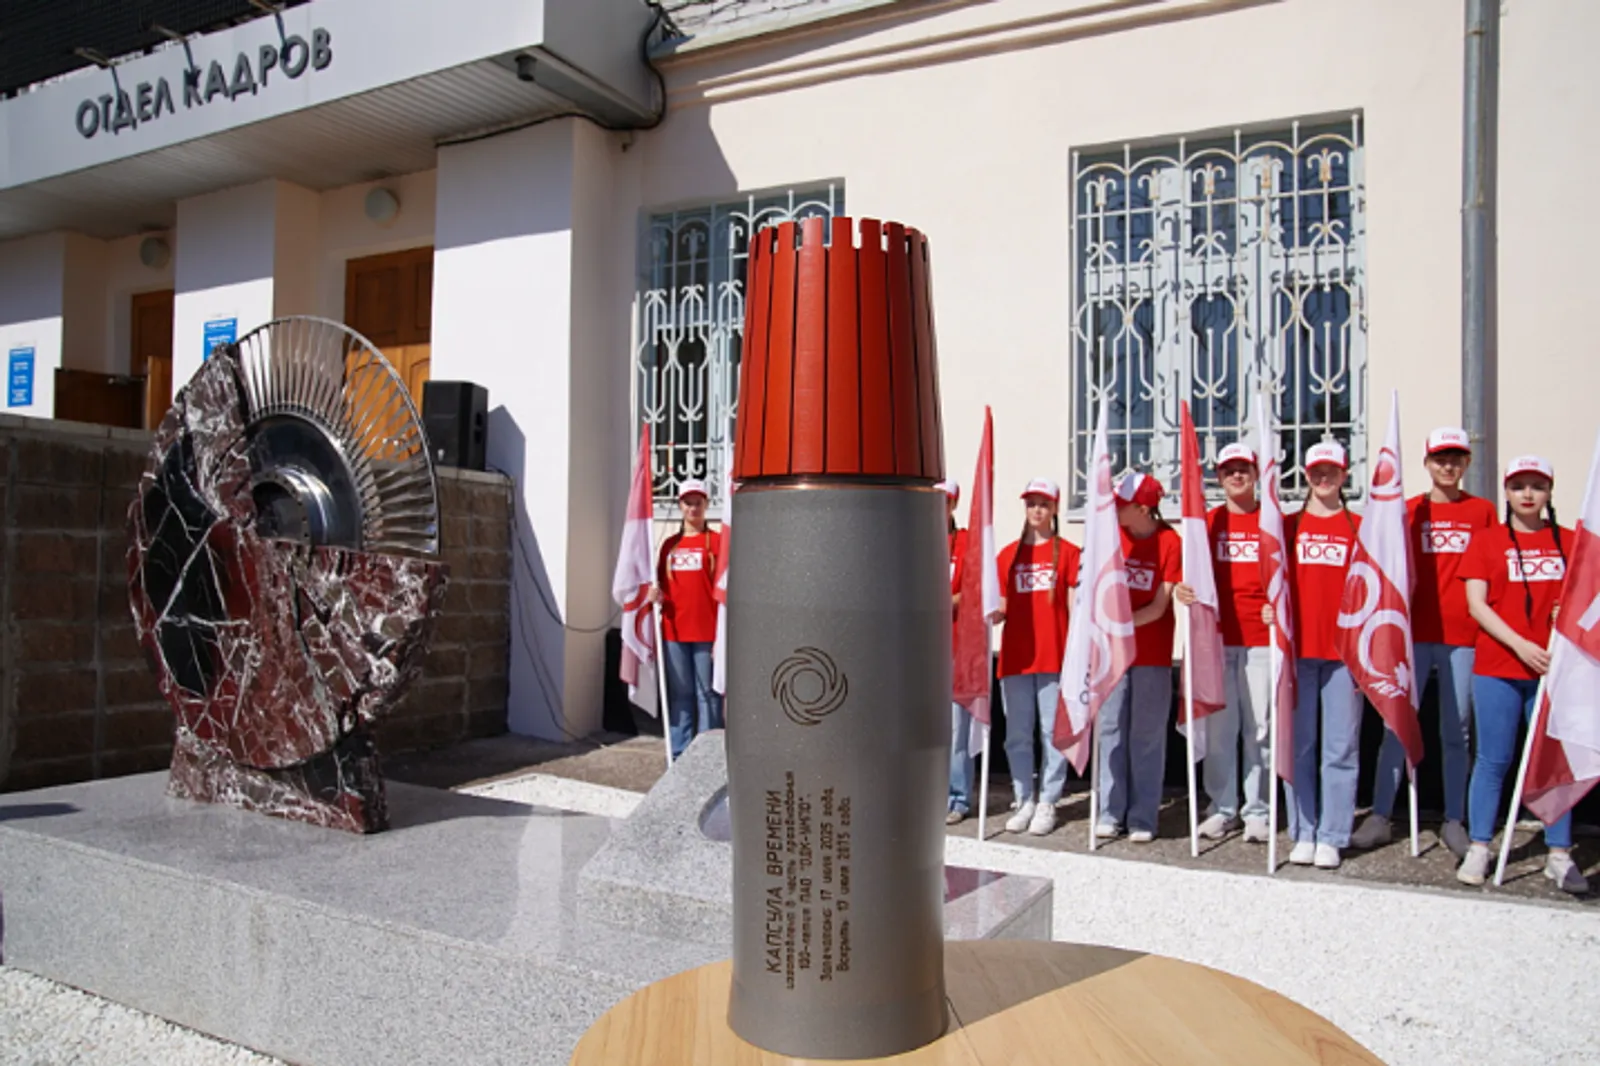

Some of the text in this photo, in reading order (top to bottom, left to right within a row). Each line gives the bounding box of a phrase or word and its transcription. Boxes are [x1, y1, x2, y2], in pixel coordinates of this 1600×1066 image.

[75, 27, 333, 139] ОТДЕЛ КАДРОВ
[820, 822, 833, 850] 2025
[765, 790, 783, 973] КАПСУЛА ВРЕМЕНИ
[821, 855, 833, 884] июля
[838, 866, 850, 895] июля
[799, 878, 812, 904] ПАО
[820, 889, 833, 901] 17
